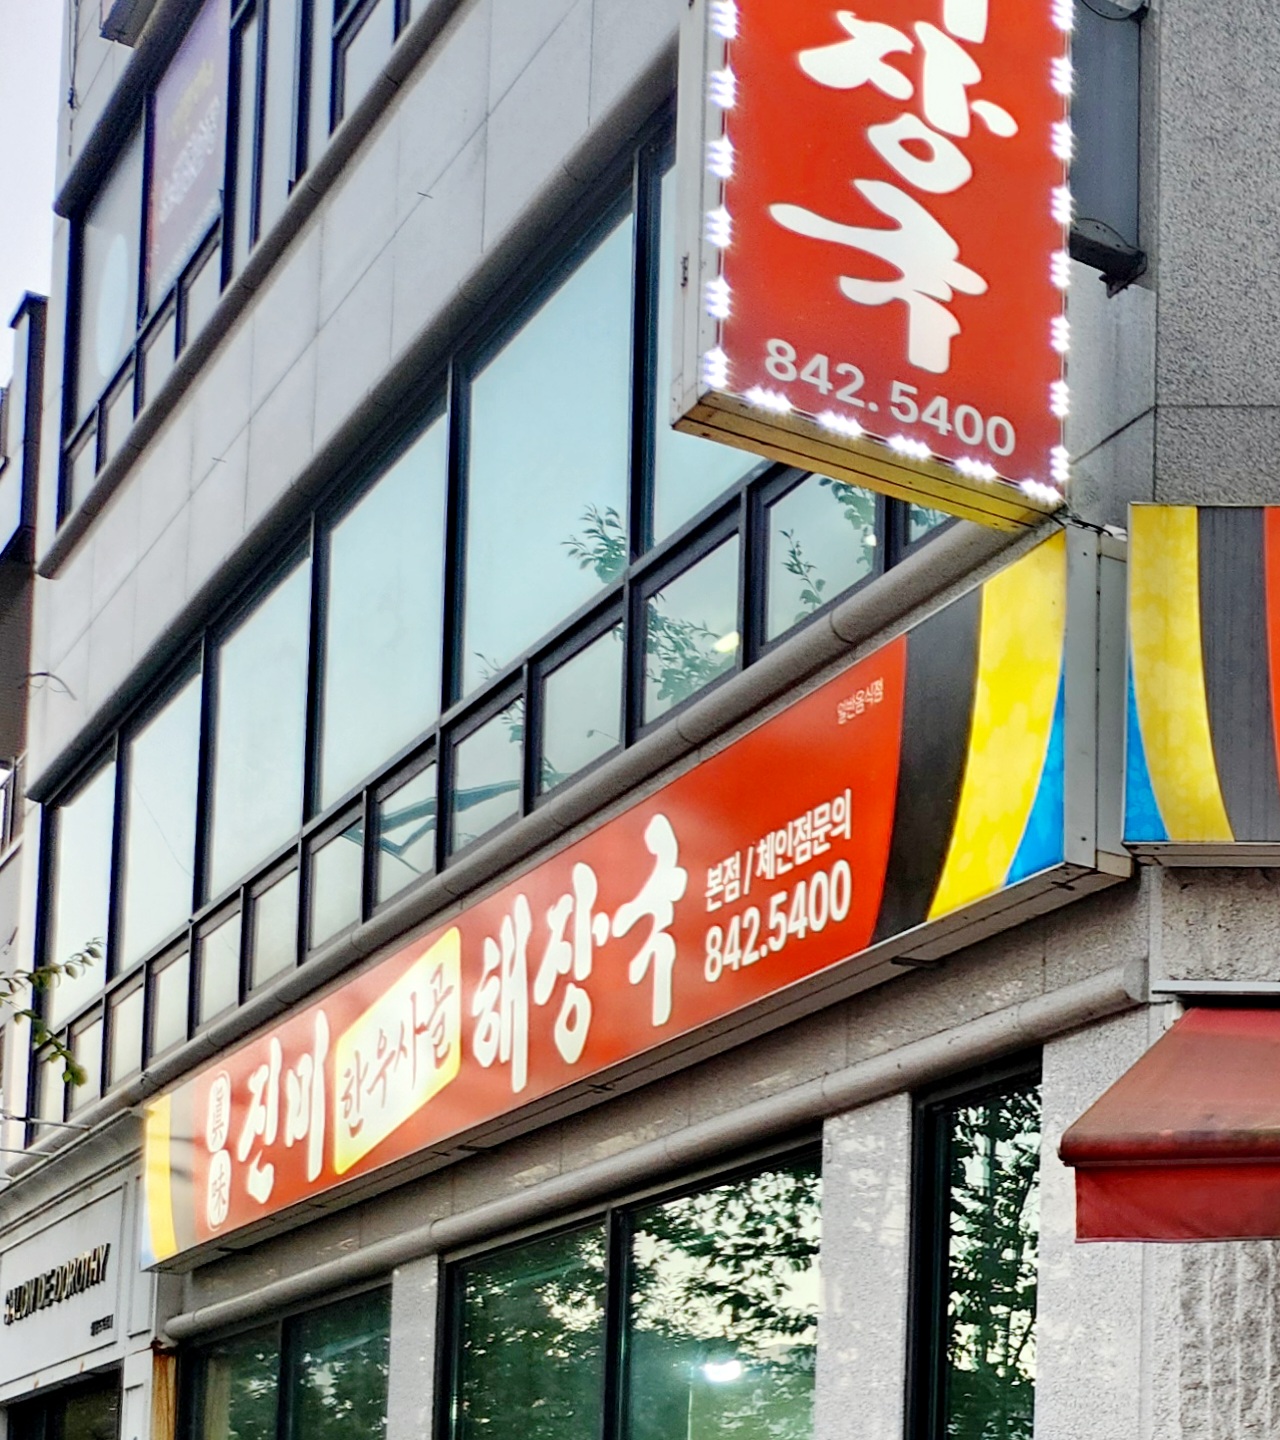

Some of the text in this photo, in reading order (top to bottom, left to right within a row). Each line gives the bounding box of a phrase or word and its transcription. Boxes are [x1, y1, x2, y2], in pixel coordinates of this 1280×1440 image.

[768, 0, 1018, 374] 장국
[765, 338, 1016, 457] 842.5400
[706, 851, 741, 912] 본점
[756, 788, 852, 880] 체인점문의
[705, 859, 852, 983] 842.5400
[237, 813, 688, 1204] 진미 한우사골 해장국
